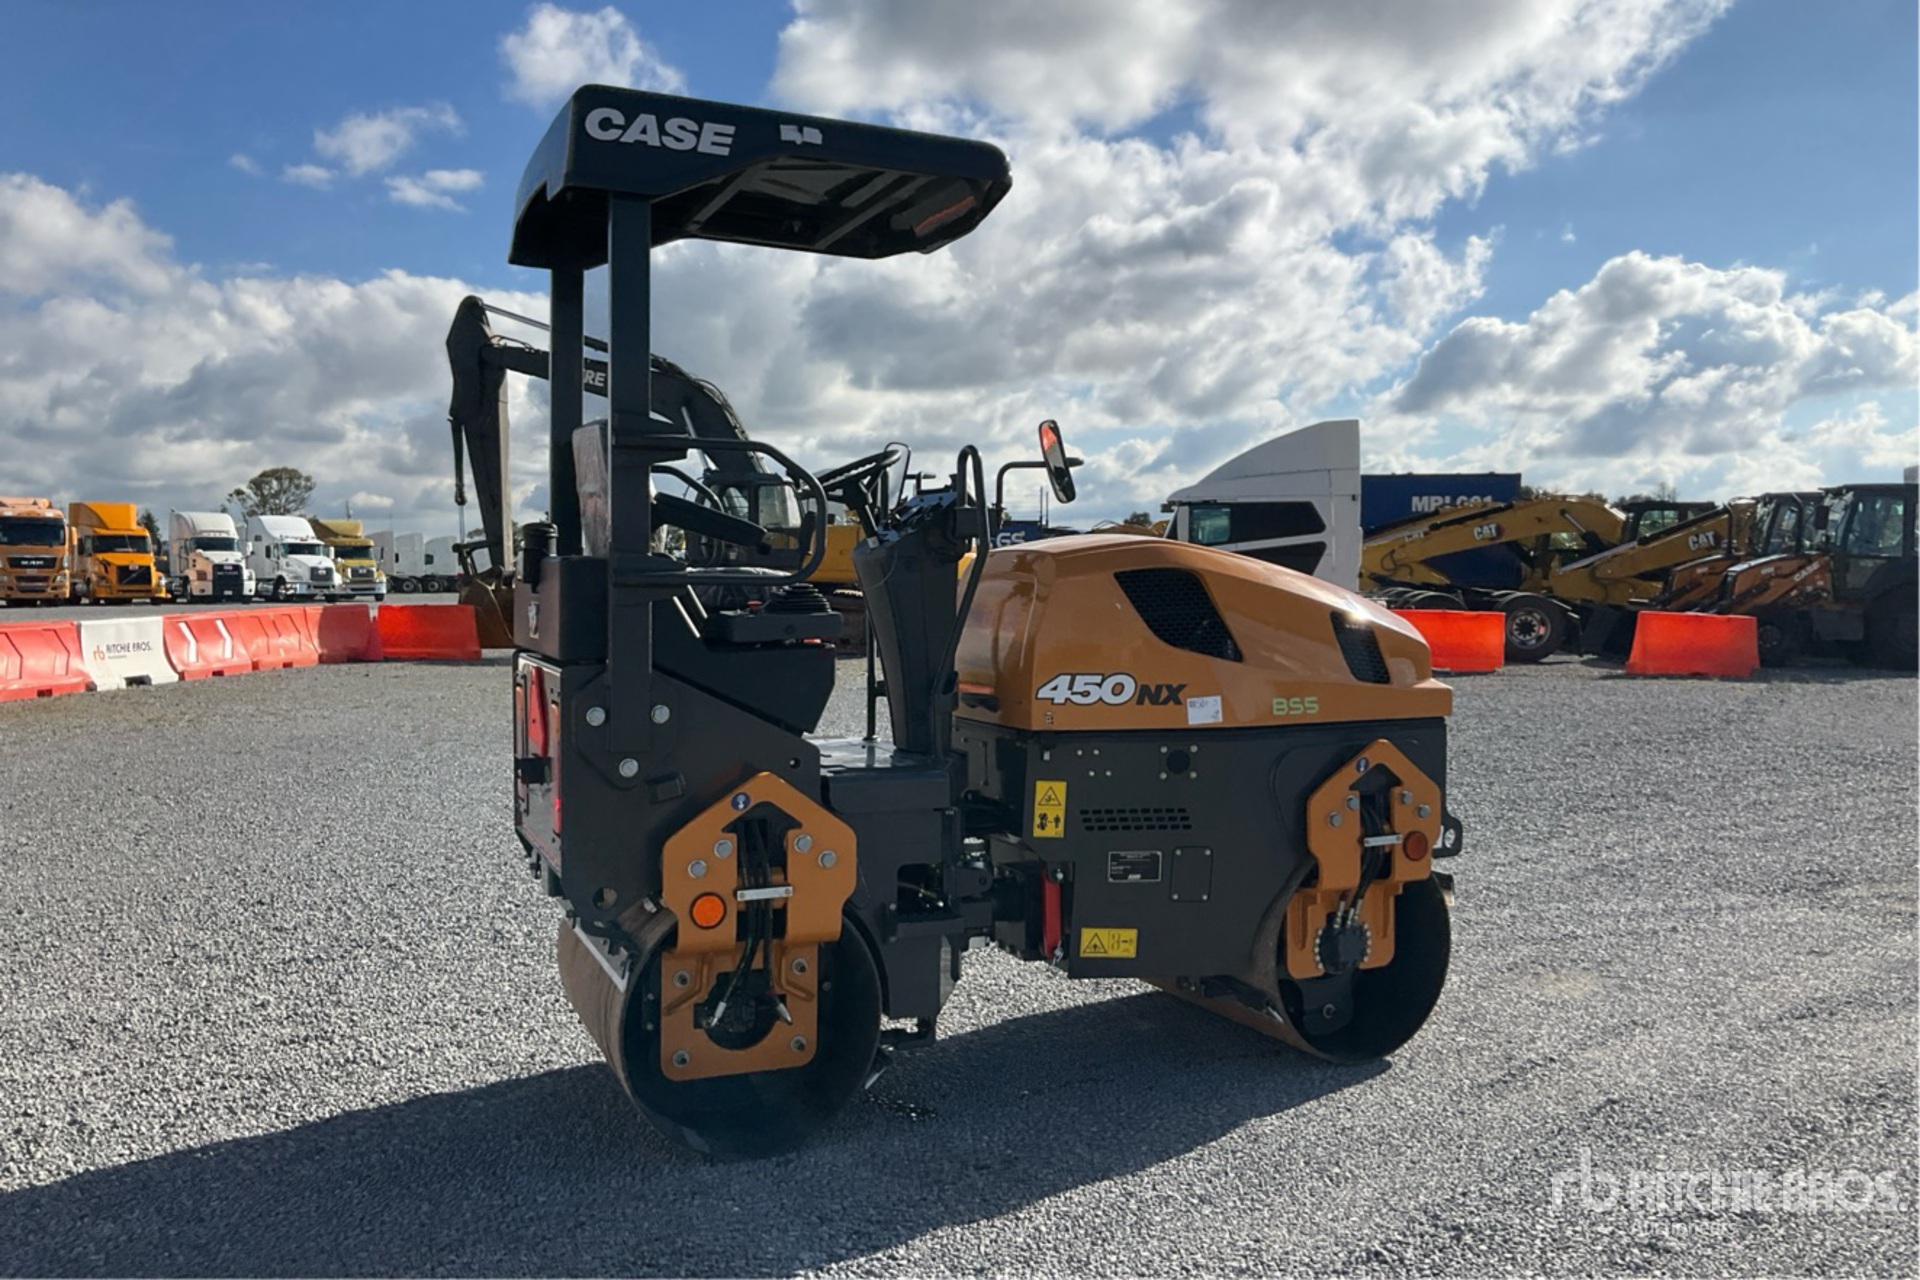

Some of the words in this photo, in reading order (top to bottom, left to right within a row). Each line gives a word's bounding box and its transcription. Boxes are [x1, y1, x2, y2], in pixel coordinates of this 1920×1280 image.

[584, 106, 736, 156] CASE
[1473, 522, 1498, 541] CAT
[1688, 531, 1716, 551] CAT
